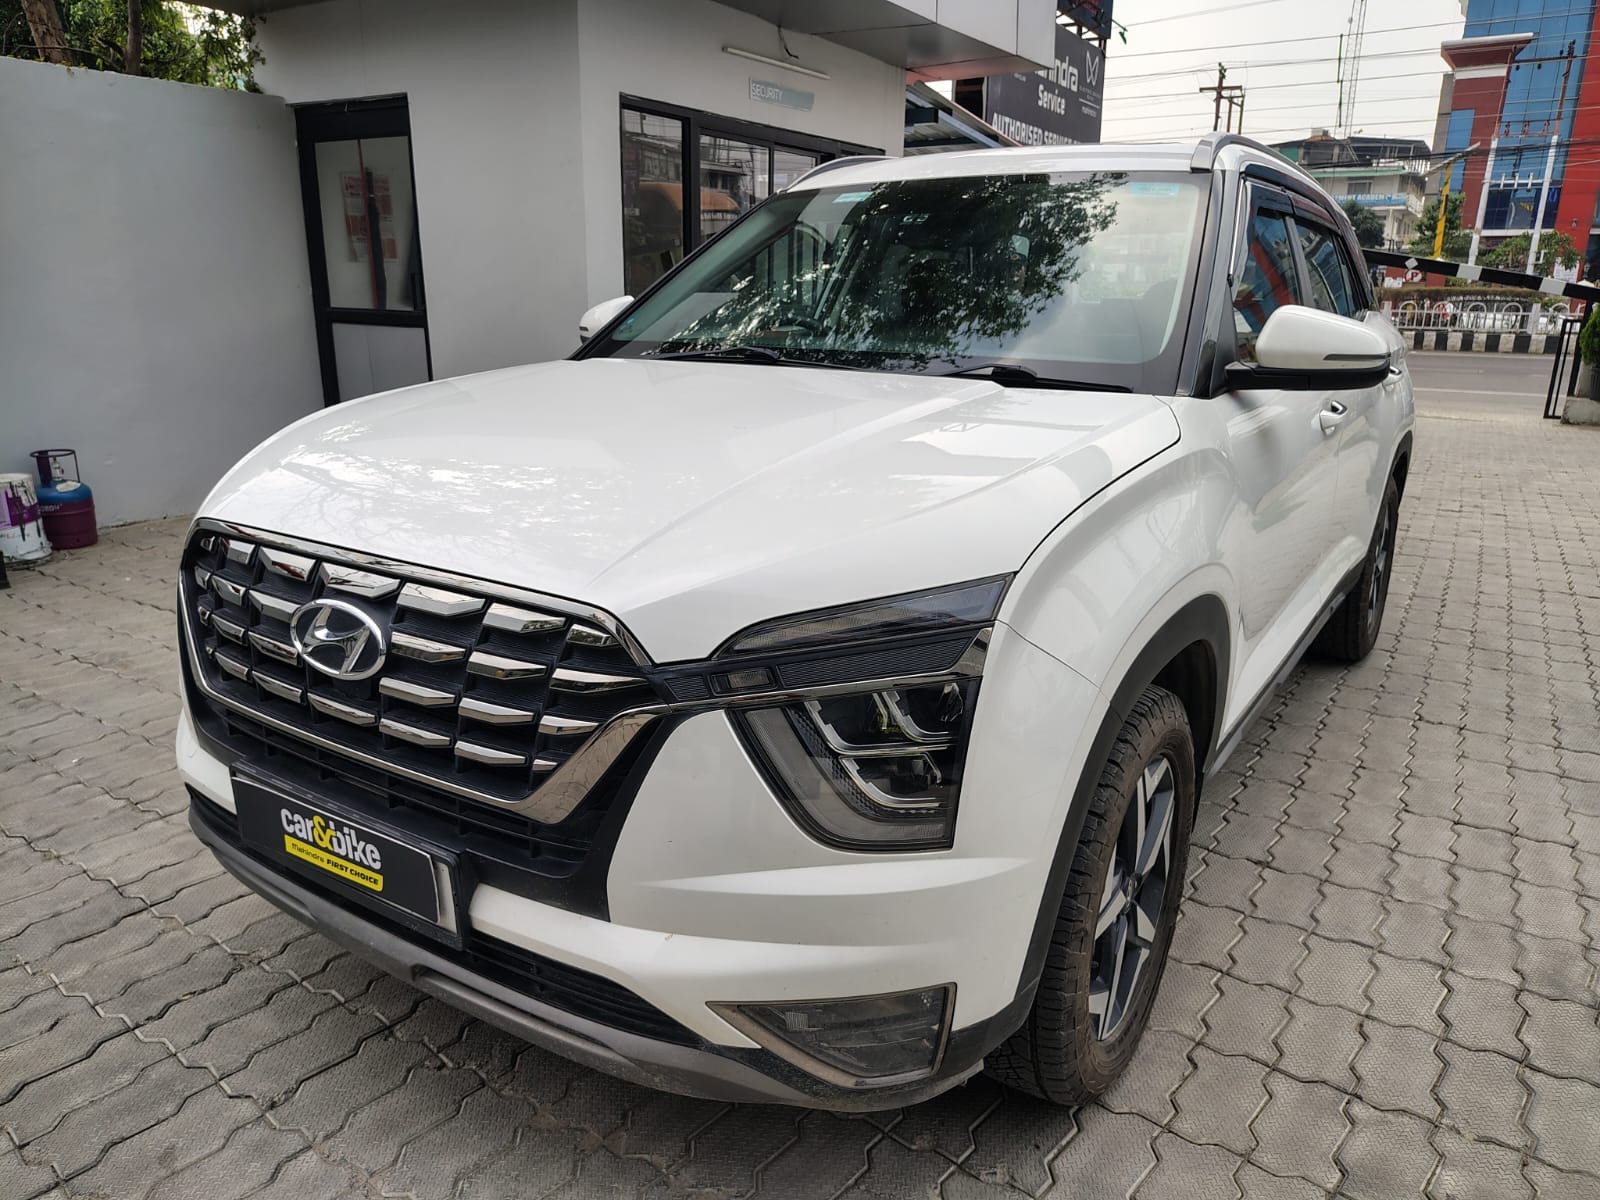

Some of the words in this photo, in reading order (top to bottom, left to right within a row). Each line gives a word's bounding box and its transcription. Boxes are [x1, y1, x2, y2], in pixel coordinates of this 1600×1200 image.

[752, 83, 783, 101] SECURITY
[1038, 84, 1066, 115] Service
[992, 112, 1043, 146] AUTHORISED
[281, 808, 382, 870] car&bike
[327, 858, 350, 873] FIRST
[350, 868, 379, 886] CHOICE
